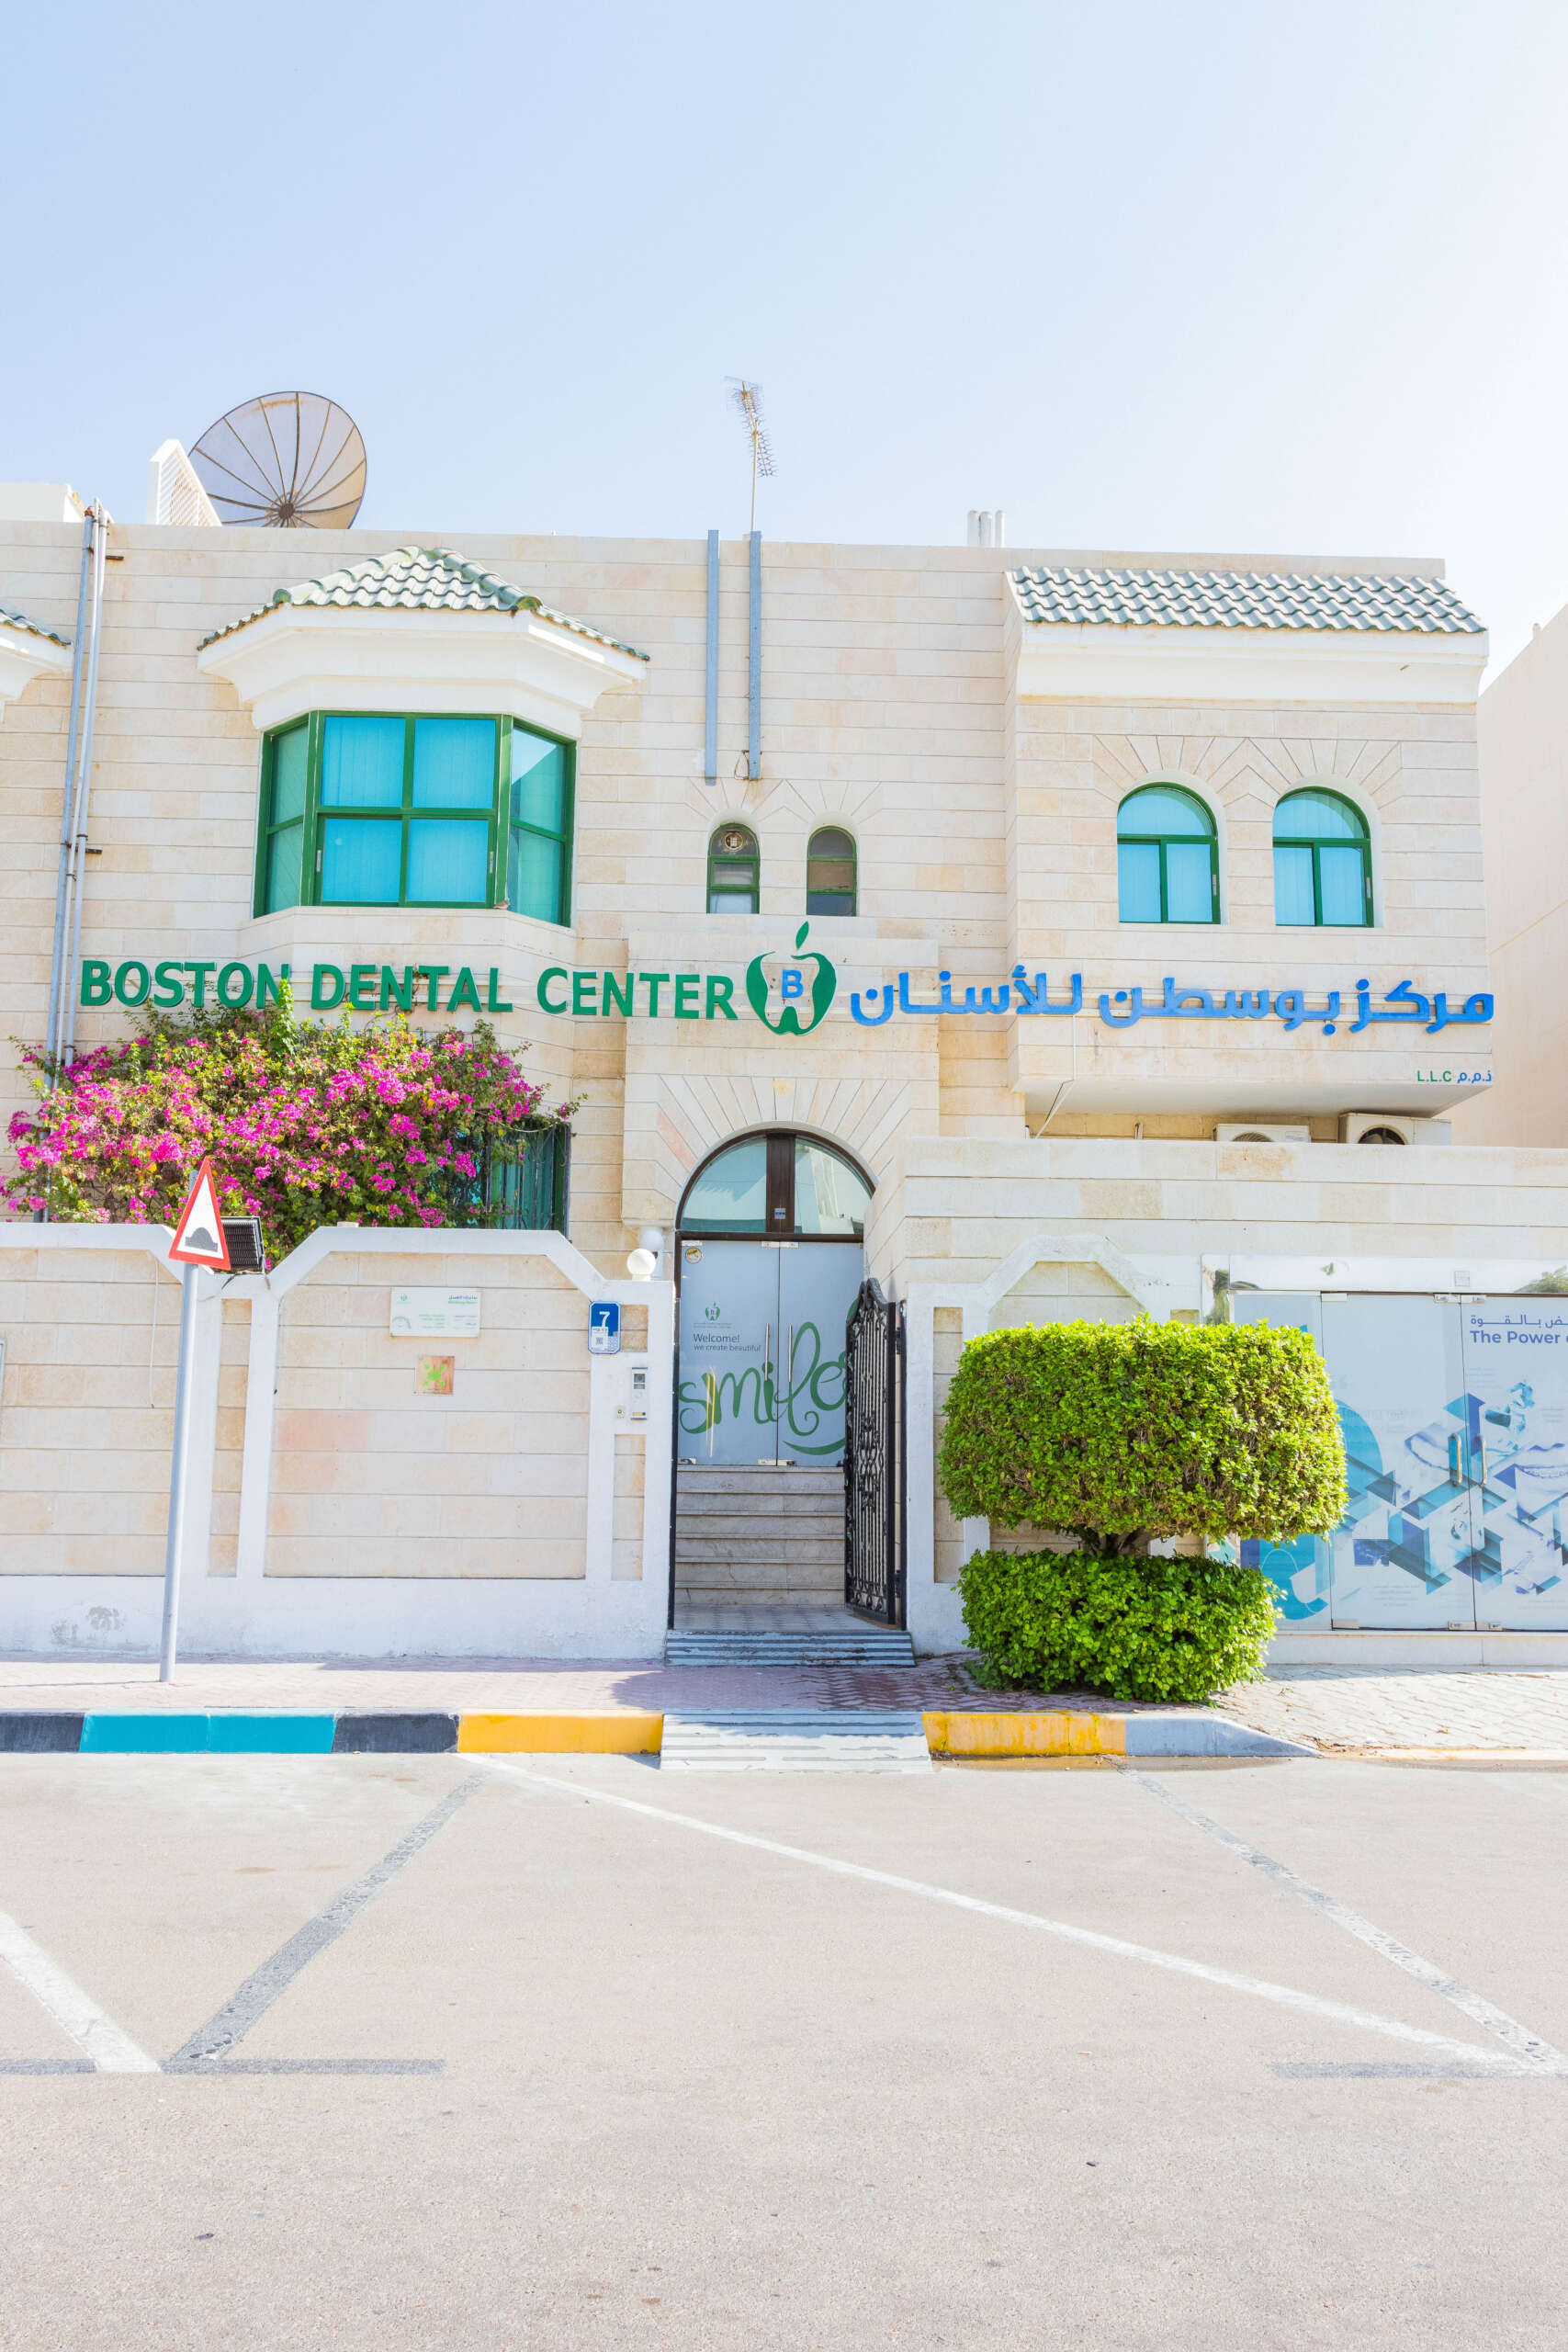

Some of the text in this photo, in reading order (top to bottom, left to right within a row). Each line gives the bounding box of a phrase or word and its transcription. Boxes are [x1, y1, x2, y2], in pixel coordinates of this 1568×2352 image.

[80, 960, 739, 1020] BOSTON DENTAL CENTER
[781, 969, 804, 998] B
[850, 964, 1495, 1035] مركز بوسطن للأسنان
[1416, 1069, 1452, 1082] L.L.C
[599, 1311, 611, 1328] 7
[693, 1333, 740, 1343] Welcome!
[1470, 1329, 1502, 1343] The
[1506, 1329, 1561, 1344] Power
[679, 1321, 846, 1437] smile
